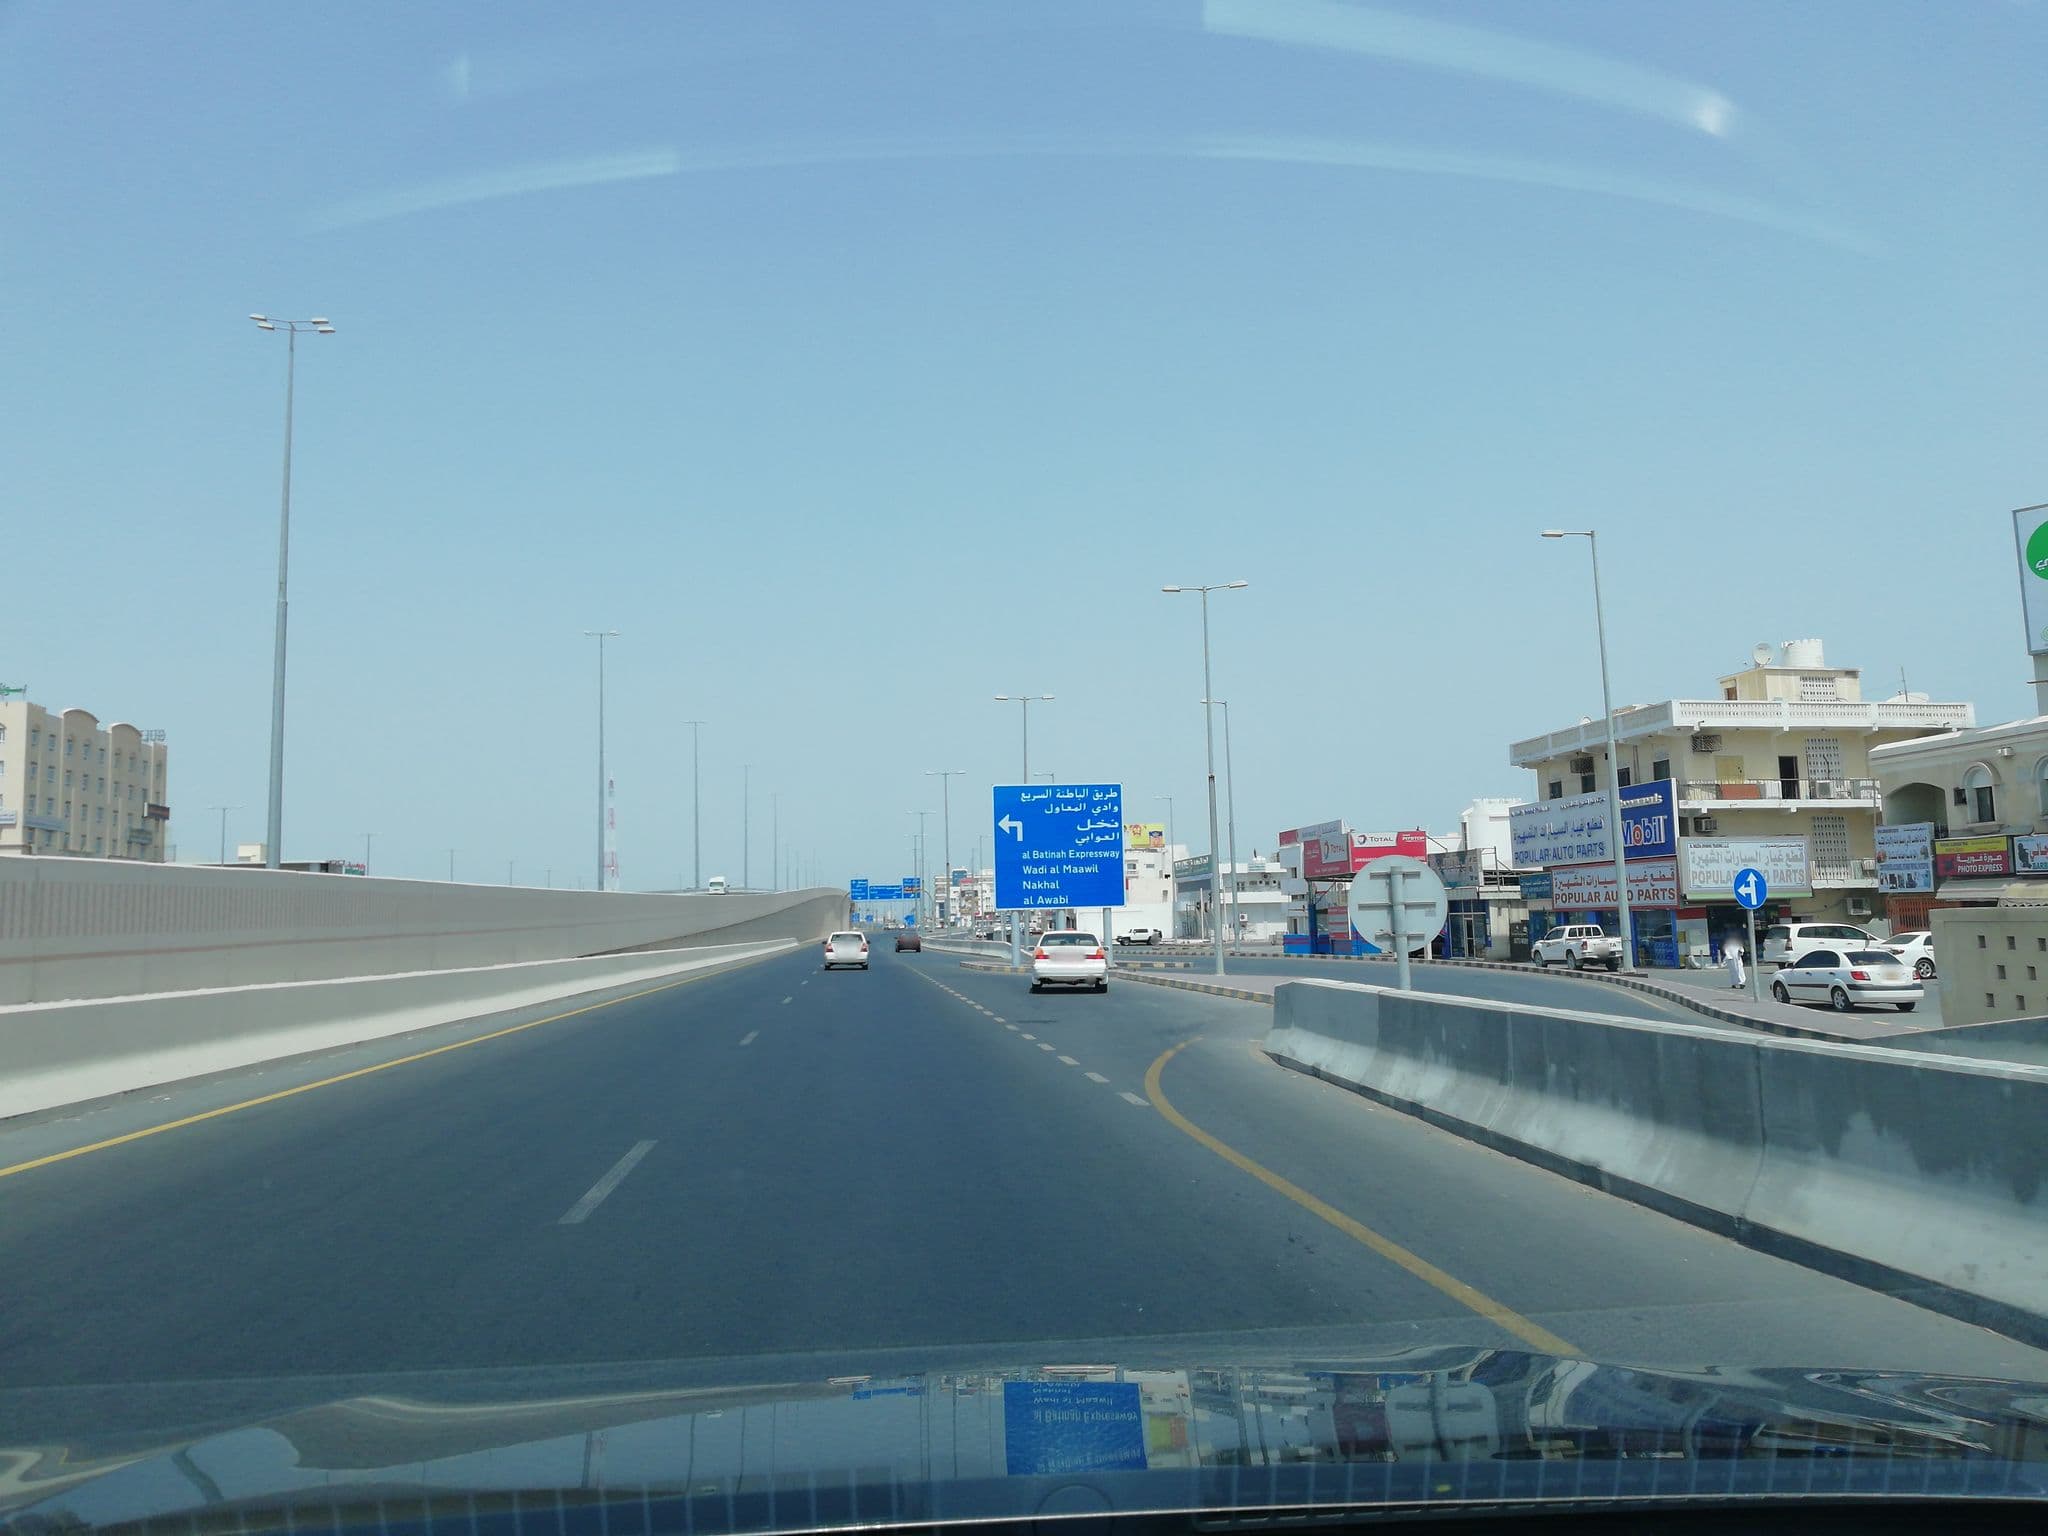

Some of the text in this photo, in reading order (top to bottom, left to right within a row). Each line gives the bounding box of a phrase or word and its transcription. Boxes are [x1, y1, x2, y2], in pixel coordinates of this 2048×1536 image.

[1020, 788, 1118, 802] طريق الباطنة السريع
[1044, 803, 1118, 816] وادي المعاول
[1077, 818, 1119, 831] نخل
[1621, 815, 1666, 847] Mobil
[1075, 832, 1120, 846] العوابي
[1022, 849, 1120, 860] al Batinah Expressway
[1514, 842, 1606, 864] POPULAR AUTO PARTS
[1022, 864, 1099, 874] Wadi al Maawil
[1957, 864, 2003, 873] PHOTO EXPRESS
[1774, 868, 1805, 884] PARTS
[1022, 880, 1060, 890] Nakhal
[1024, 895, 1069, 905] al Awabi
[1554, 888, 1676, 904] POPULAR AUO PARTS
